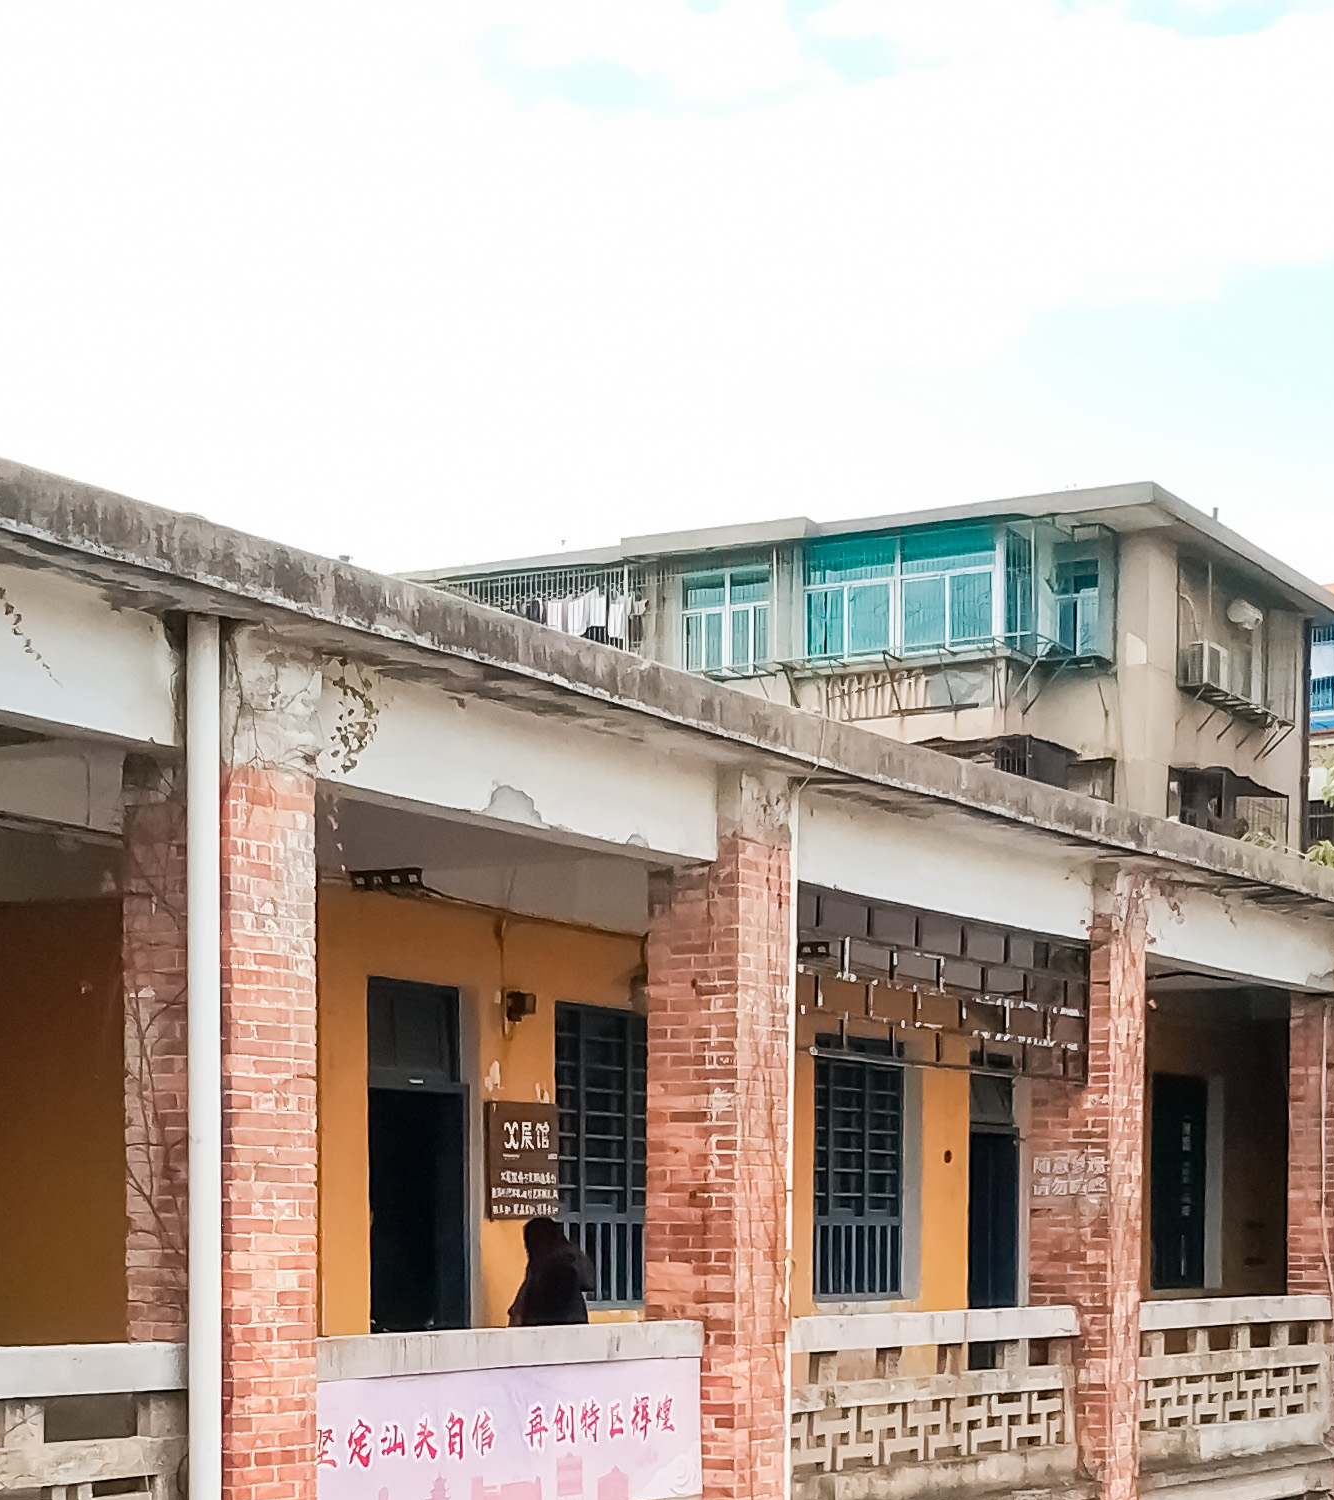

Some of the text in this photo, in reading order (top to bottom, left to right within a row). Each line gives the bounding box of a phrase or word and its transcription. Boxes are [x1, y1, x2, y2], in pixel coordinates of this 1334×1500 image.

[524, 1394, 676, 1449] 再创特区辉煌
